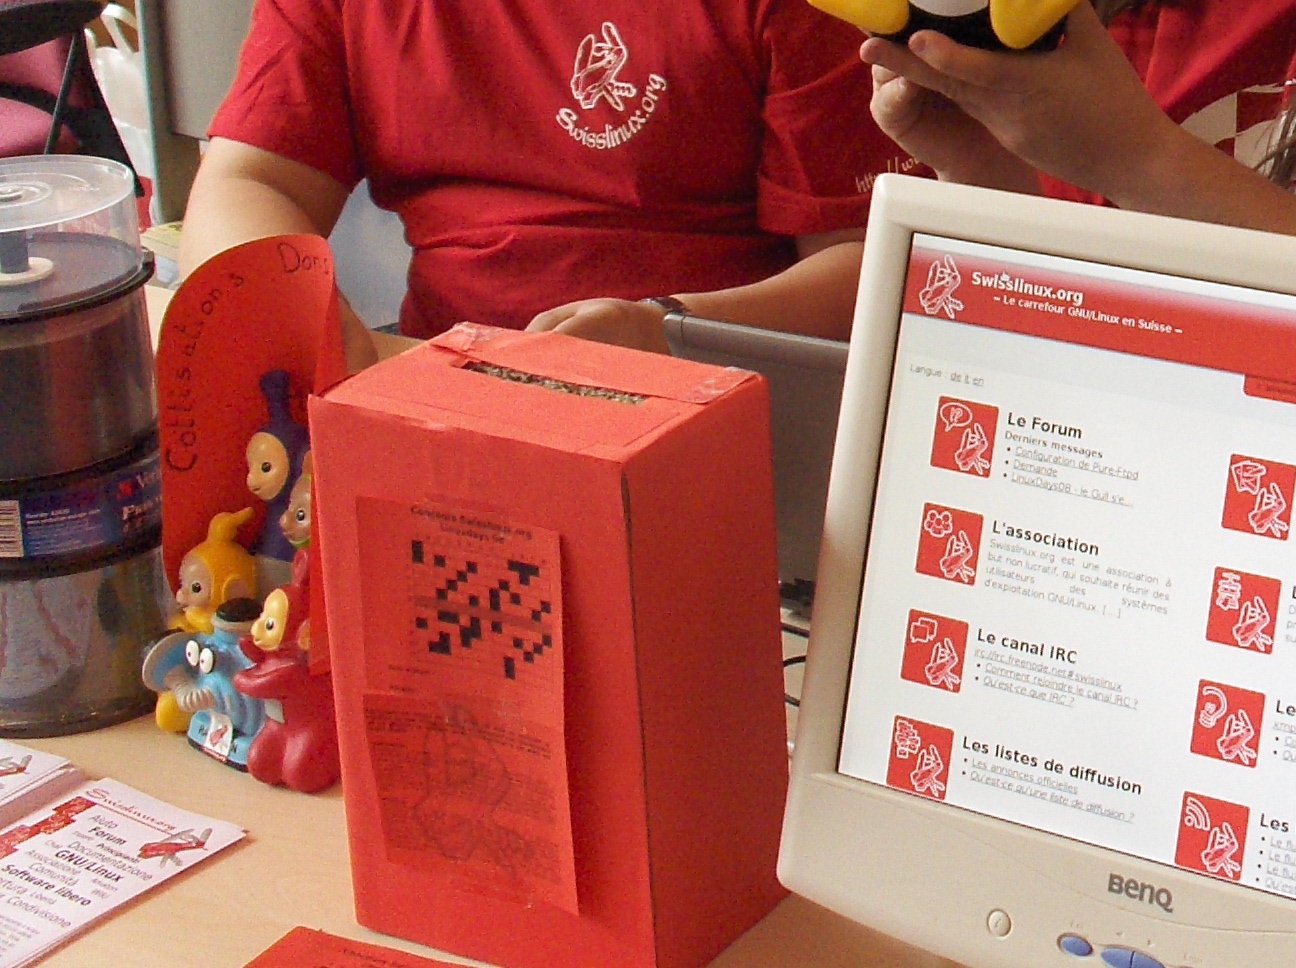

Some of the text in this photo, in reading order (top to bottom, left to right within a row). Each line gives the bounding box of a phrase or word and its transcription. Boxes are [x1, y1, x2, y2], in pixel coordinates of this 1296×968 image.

[555, 73, 668, 149] Swisslinux.org
[971, 271, 1083, 306] Swisslinux.org
[1003, 296, 1172, 334] Le carrefour GNU/Linux en Suisse
[1008, 412, 1082, 440] Le Forum
[1004, 430, 1103, 460] Derniers messages
[992, 521, 1100, 557] L'association
[977, 627, 1078, 664] Le canal IRC
[1275, 699, 1296, 717] Le
[962, 735, 1141, 795] Les listes de diffusion
[88, 826, 127, 846] Forum
[1259, 813, 1289, 832] Les
[55, 849, 126, 883] GNU/Linux
[1, 864, 91, 906] Software libero
[1108, 873, 1173, 913] BenQ
